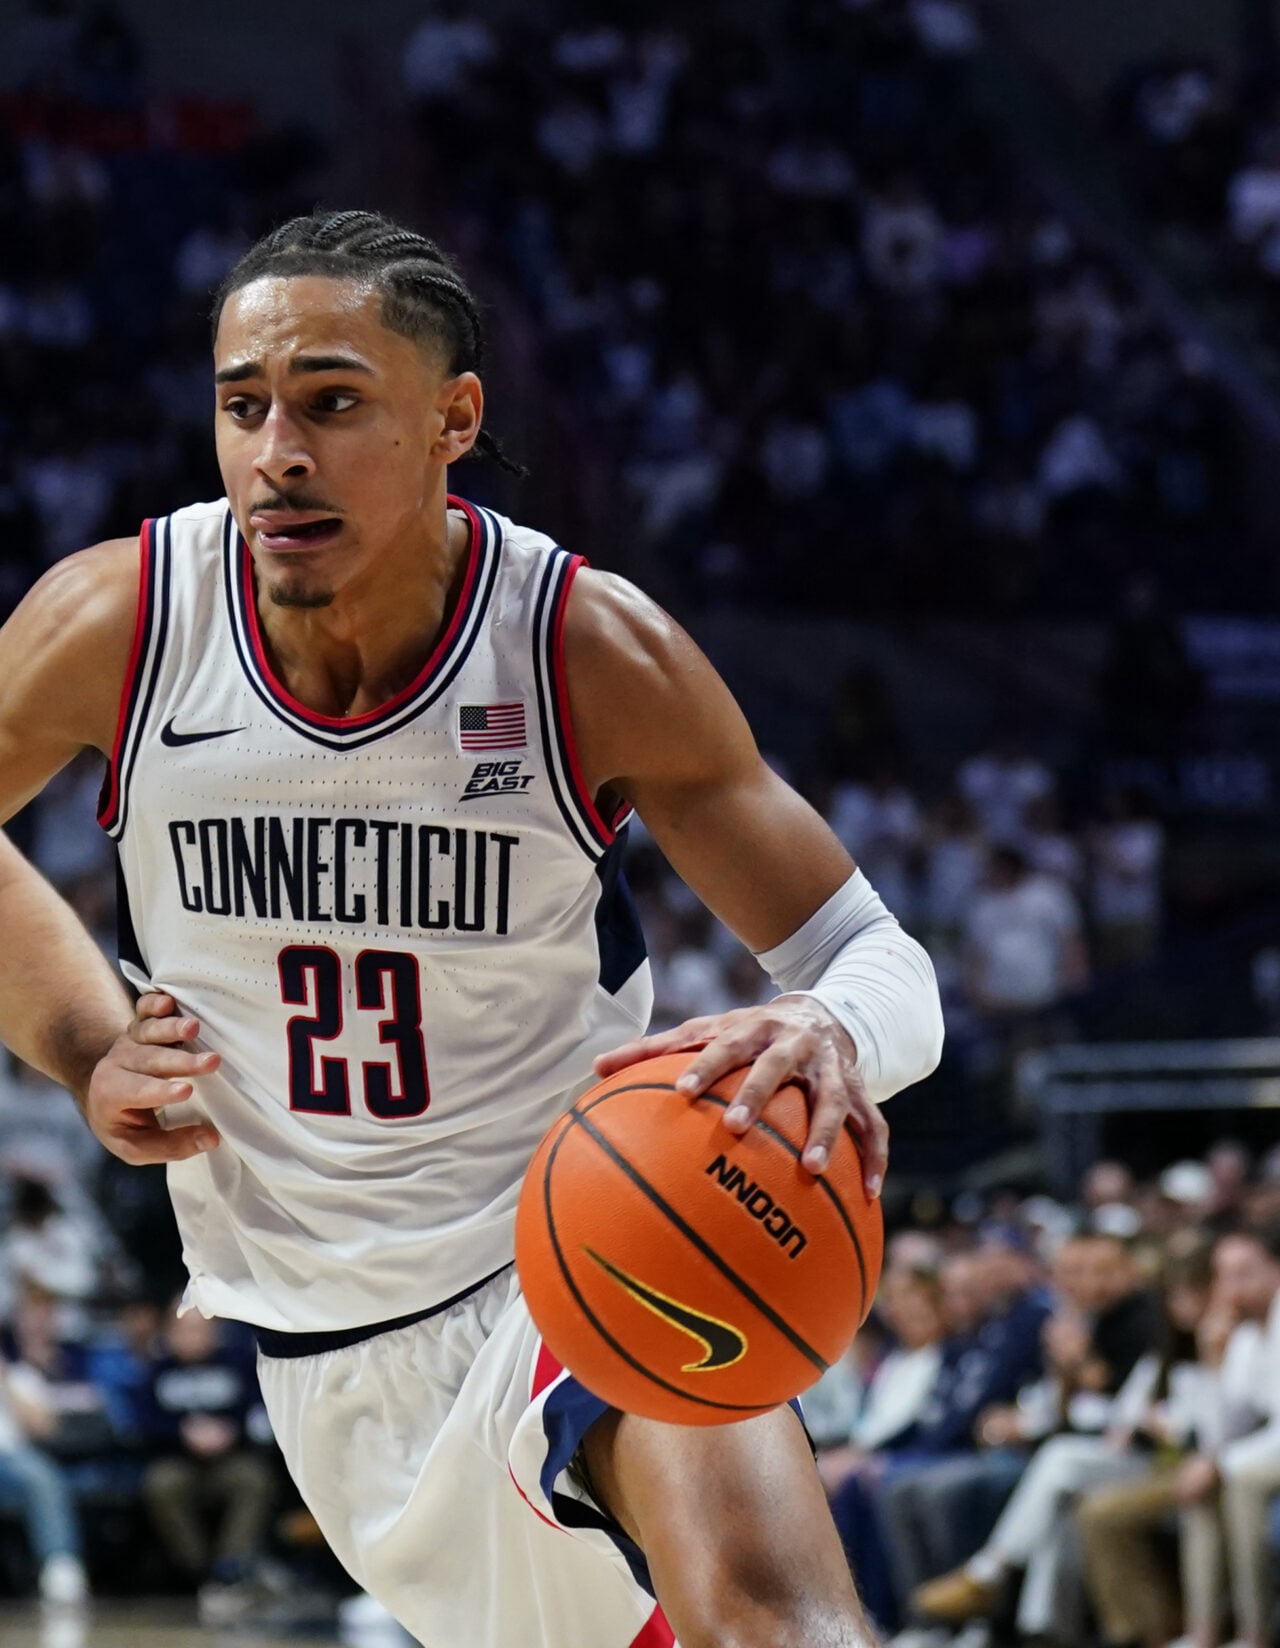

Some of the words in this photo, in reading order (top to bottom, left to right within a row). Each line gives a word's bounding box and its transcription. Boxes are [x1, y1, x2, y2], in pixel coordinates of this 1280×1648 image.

[464, 774, 535, 793] EAST
[471, 760, 523, 779] BIG
[168, 816, 520, 935] CONNECTICUT
[277, 945, 431, 1119] 23
[705, 1154, 808, 1260] UCONN
